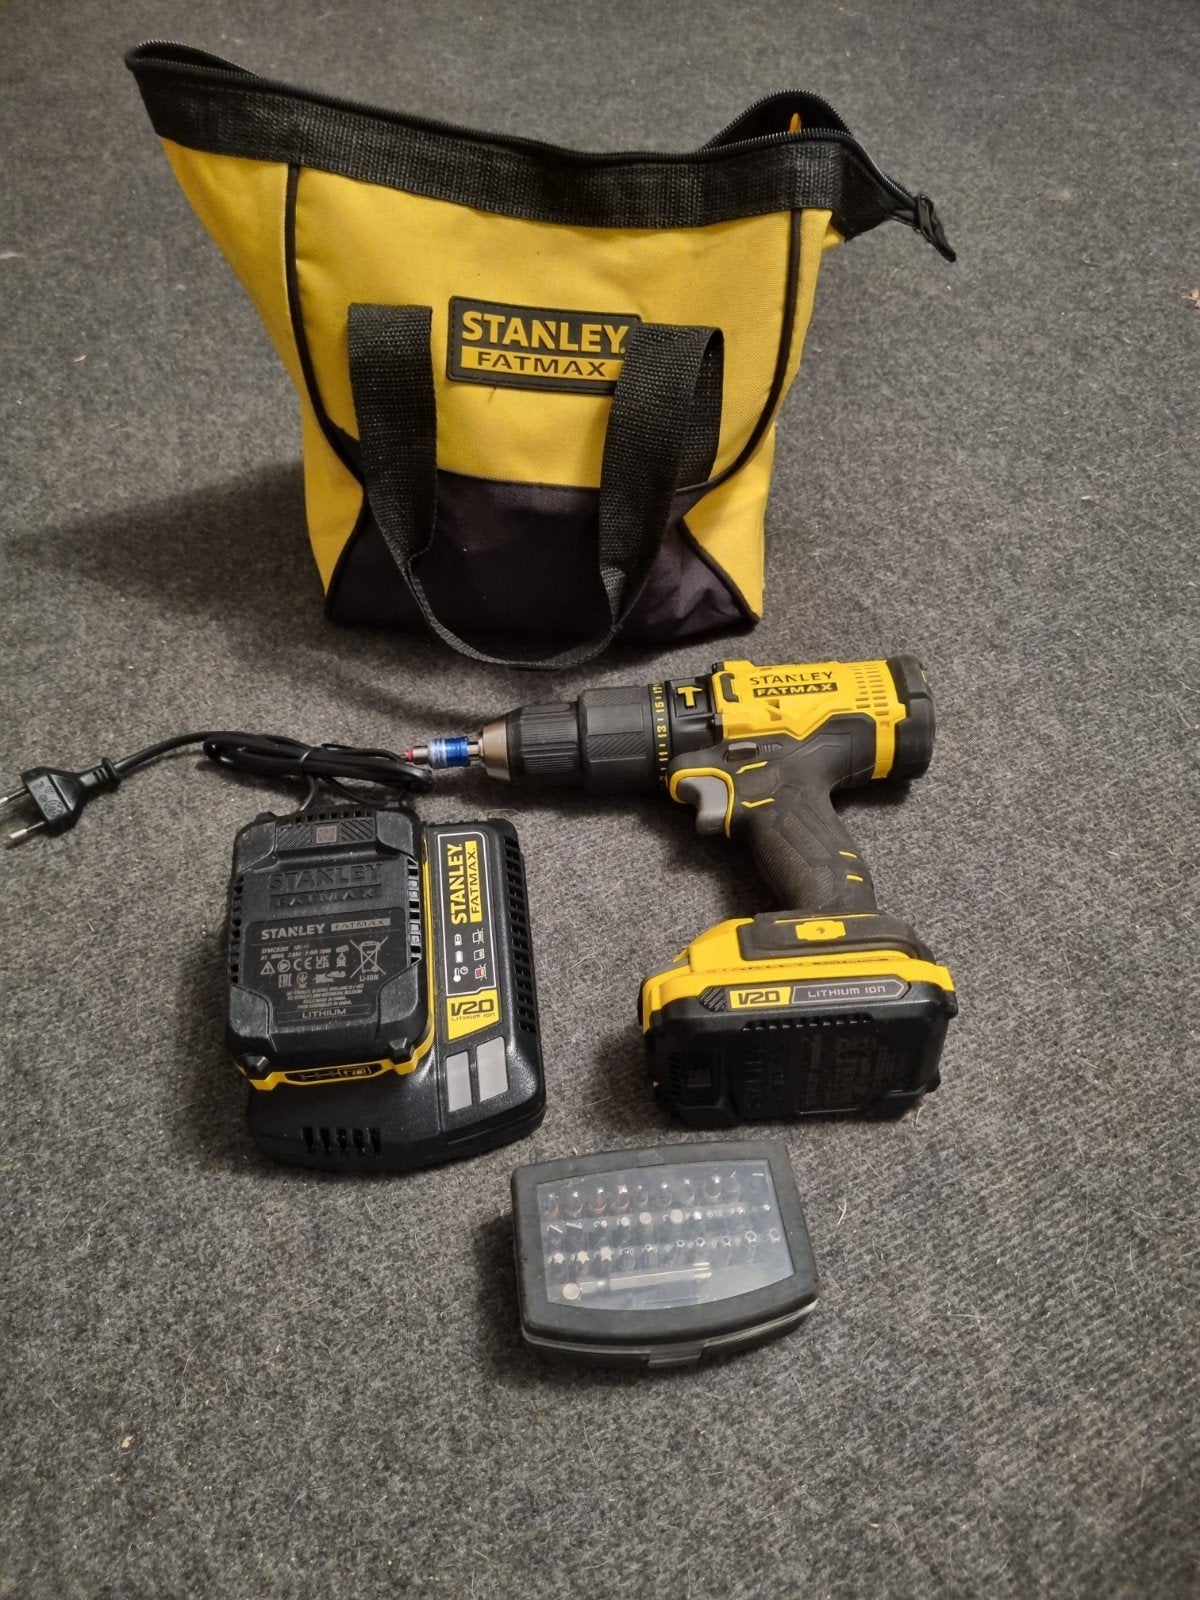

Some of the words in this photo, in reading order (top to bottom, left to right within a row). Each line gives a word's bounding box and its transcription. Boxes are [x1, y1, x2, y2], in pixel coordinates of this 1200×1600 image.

[461, 311, 629, 354] STANLEY
[476, 351, 606, 377] FATMAX
[749, 671, 833, 686] STANLEY
[757, 683, 833, 696] FATMAX
[654, 701, 665, 713] 15
[656, 725, 667, 738] 13
[658, 751, 669, 762] 11
[447, 843, 468, 925] STANLEY
[467, 850, 480, 914] FATMAX
[261, 923, 325, 940] STANLEY
[335, 920, 385, 930] FATMAX
[738, 991, 781, 1005] V20
[807, 987, 860, 998] LITHIUM
[302, 1008, 347, 1019] LITHIUM
[450, 999, 495, 1016] V20
